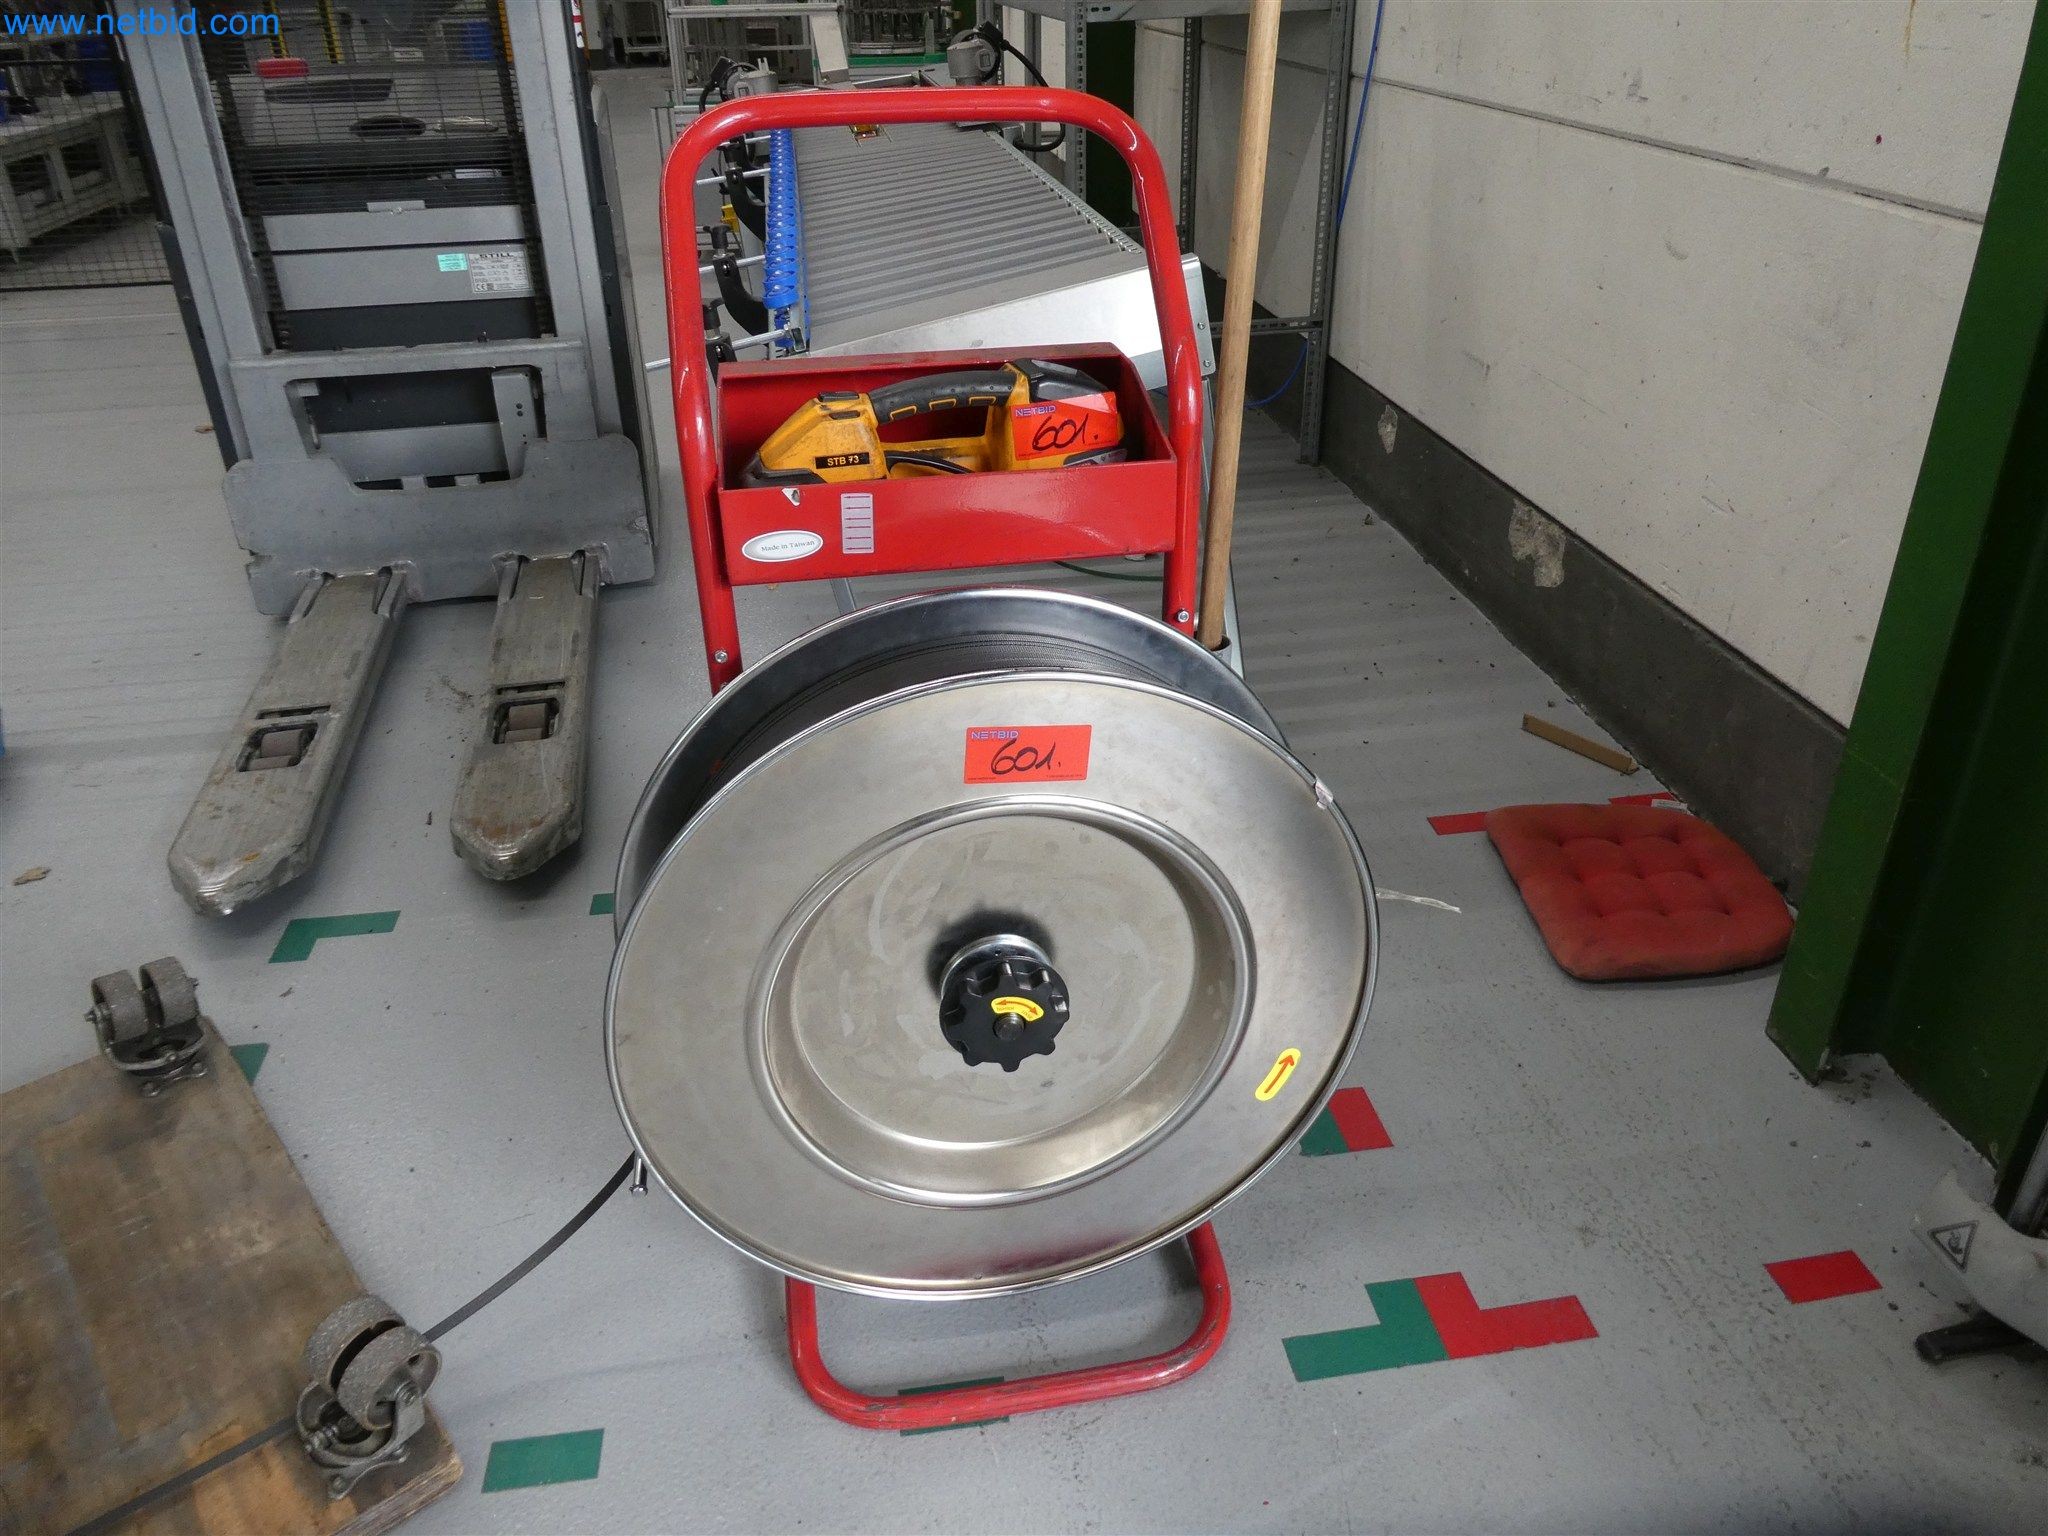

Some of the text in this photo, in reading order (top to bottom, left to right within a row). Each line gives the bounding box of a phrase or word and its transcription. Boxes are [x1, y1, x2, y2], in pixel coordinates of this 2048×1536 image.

[1015, 405, 1056, 417] NETBID
[827, 457, 846, 466] STB
[789, 540, 815, 548] Taiwan
[971, 730, 1019, 739] NETBID
